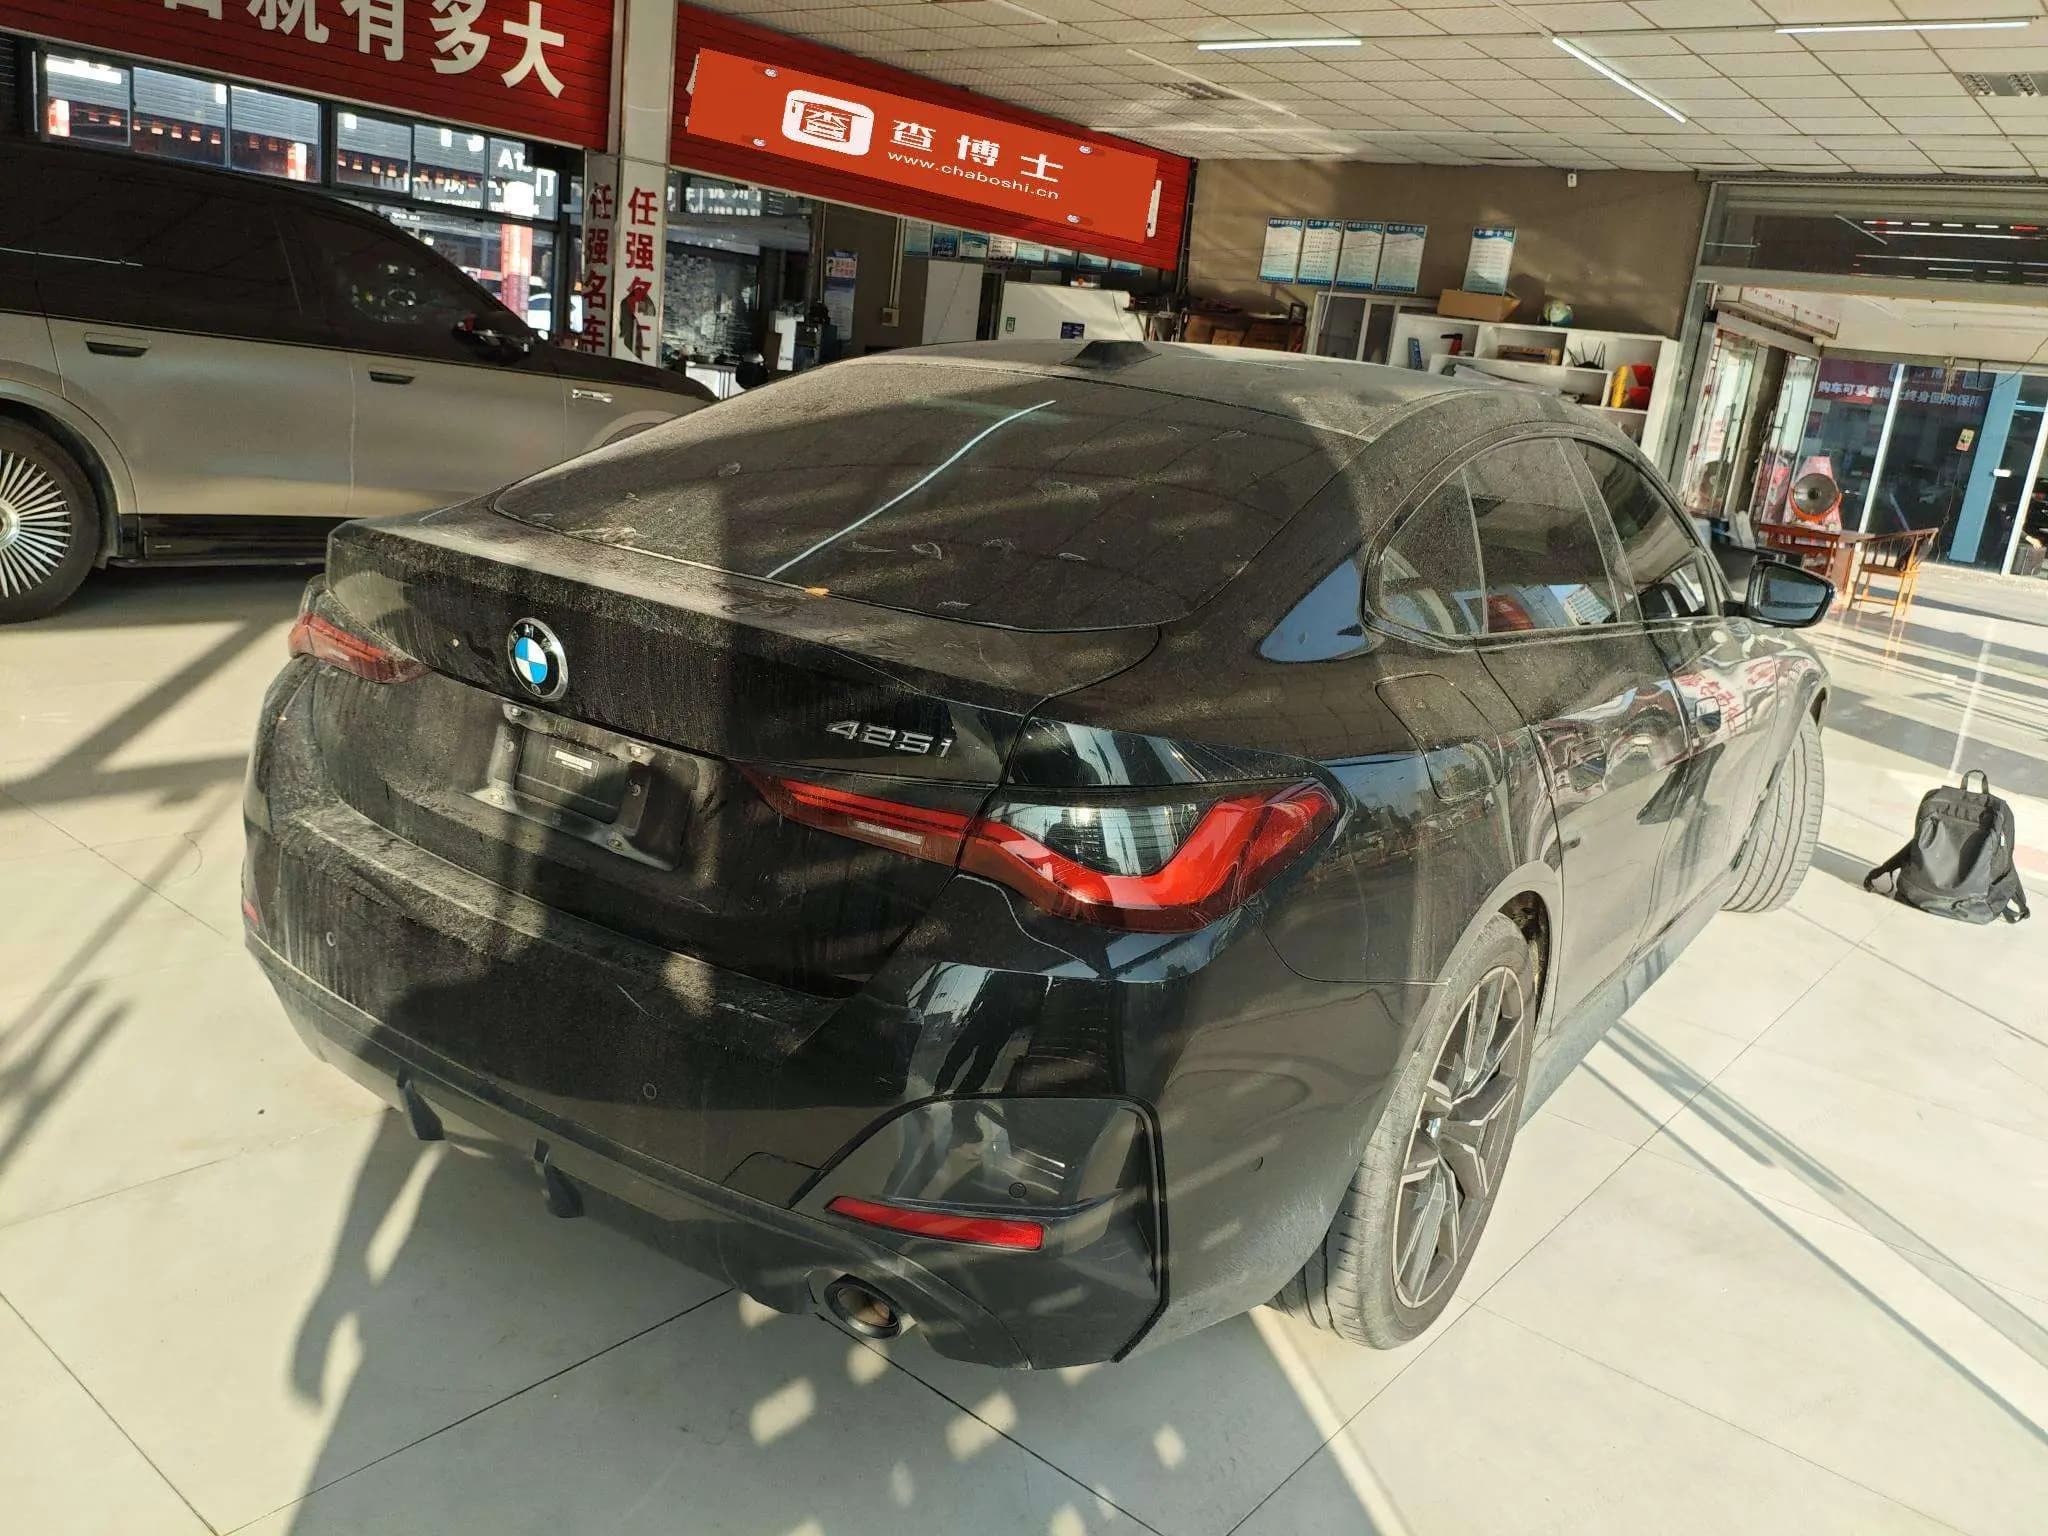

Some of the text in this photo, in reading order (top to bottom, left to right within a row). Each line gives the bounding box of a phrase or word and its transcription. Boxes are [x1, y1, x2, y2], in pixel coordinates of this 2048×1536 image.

[164, 0, 567, 99] 有多大
[582, 182, 614, 354] 任强名车
[825, 720, 953, 758] 425i
